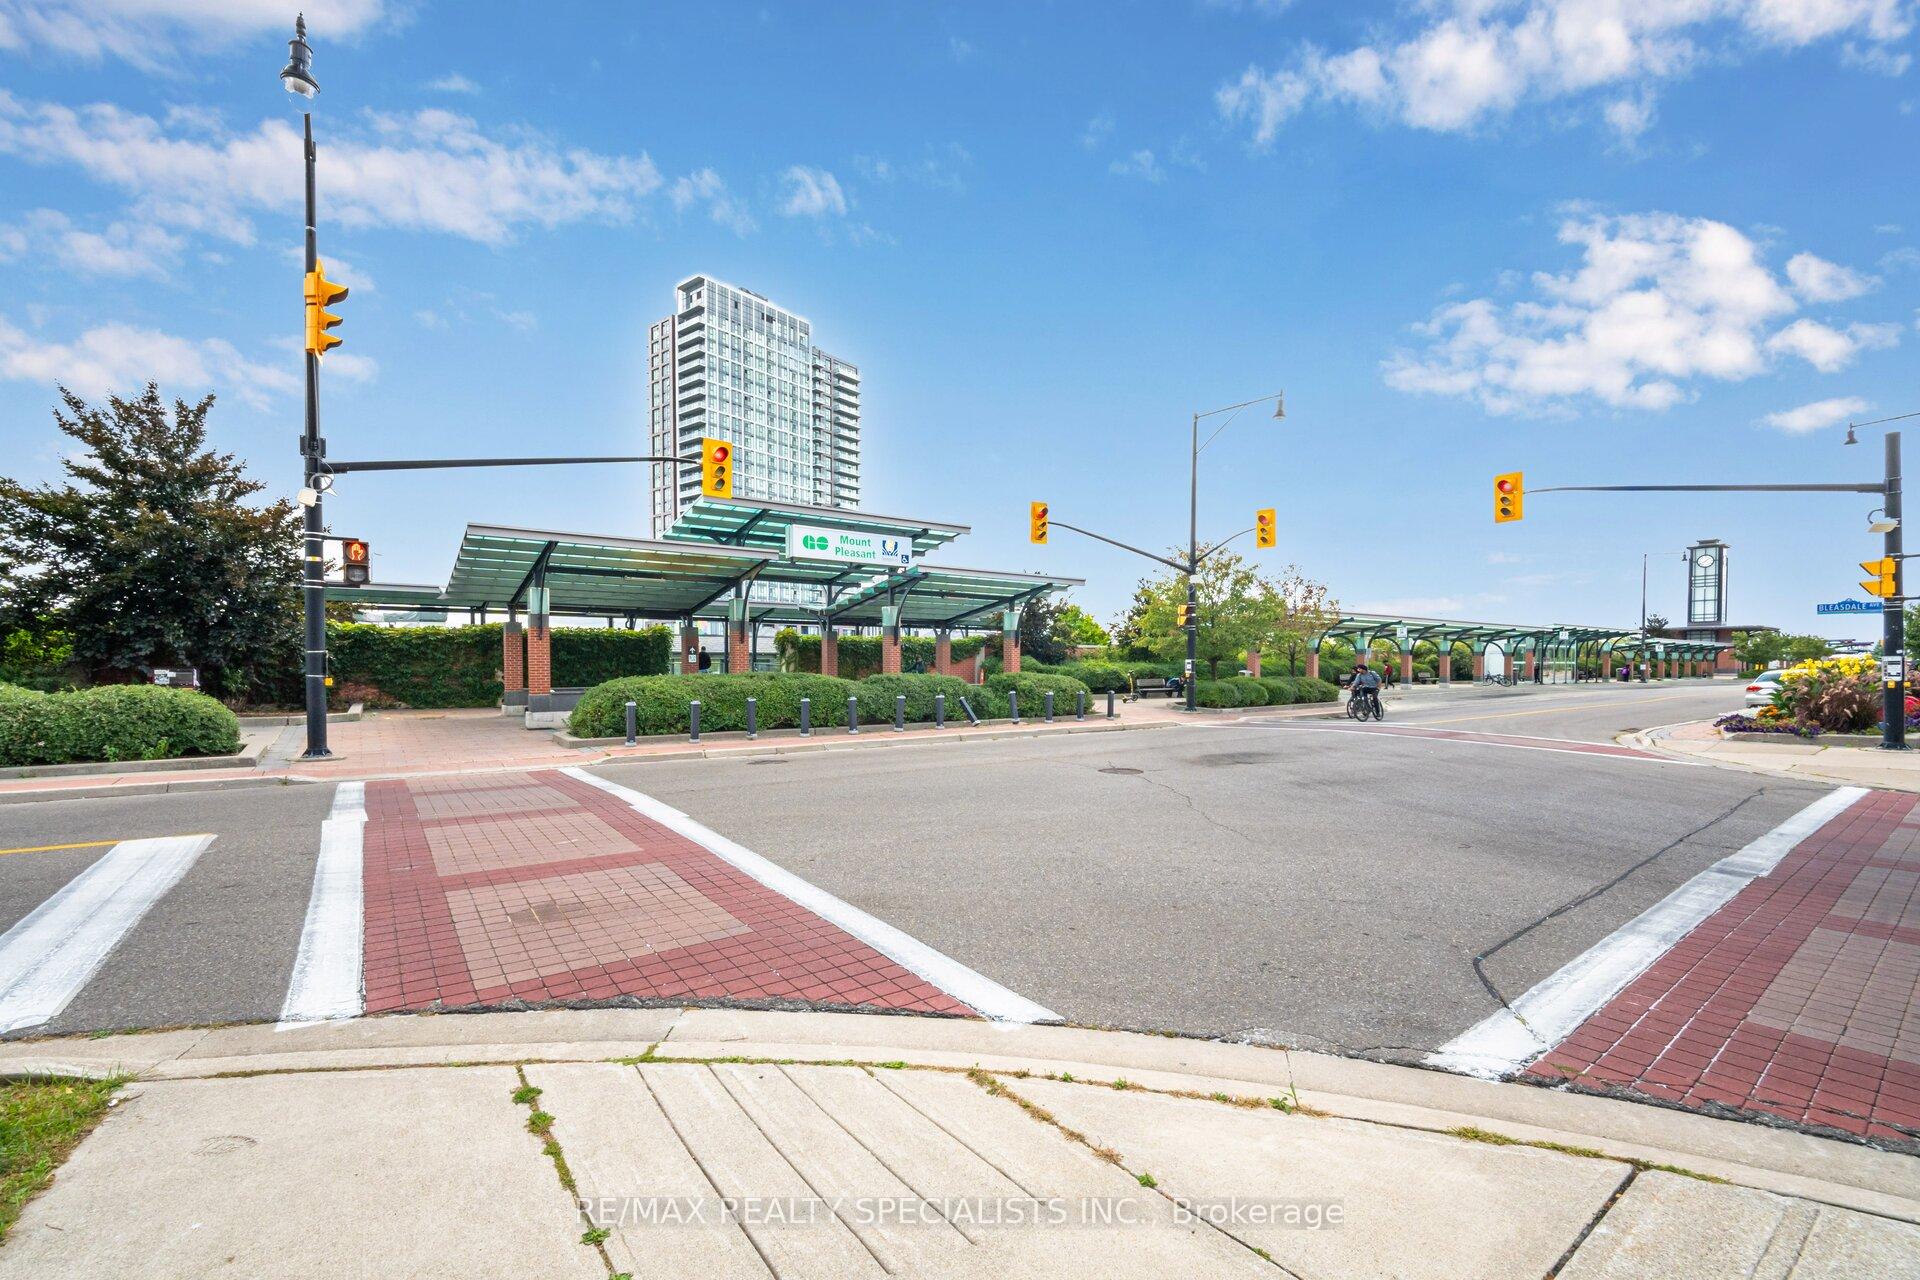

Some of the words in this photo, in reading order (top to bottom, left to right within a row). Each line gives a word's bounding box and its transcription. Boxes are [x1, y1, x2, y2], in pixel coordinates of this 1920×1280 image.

[840, 535, 871, 547] Mount
[835, 546, 876, 559] Pleasant
[1818, 603, 1867, 612] BLEASDALE
